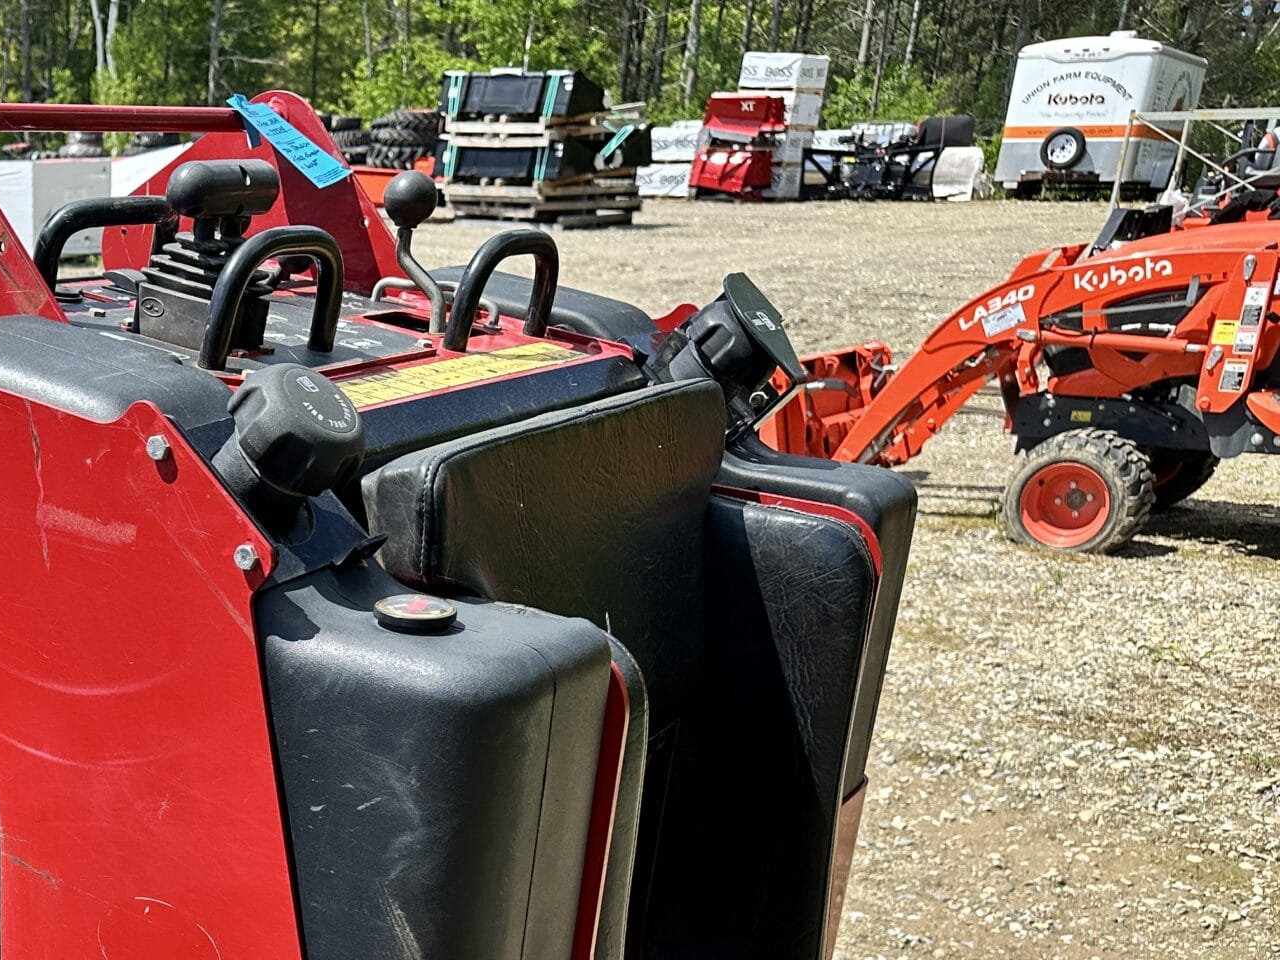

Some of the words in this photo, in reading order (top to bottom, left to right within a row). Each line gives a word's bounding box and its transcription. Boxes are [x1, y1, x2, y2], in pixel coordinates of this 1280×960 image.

[1022, 80, 1050, 104] UNION
[1053, 71, 1082, 84] FARM
[1085, 71, 1133, 101] EQUIPMENT
[1047, 92, 1106, 106] Kubota
[740, 101, 756, 112] XT
[1074, 258, 1173, 292] Kubota
[958, 285, 1035, 331] LA340
[302, 401, 324, 421] ONLY
